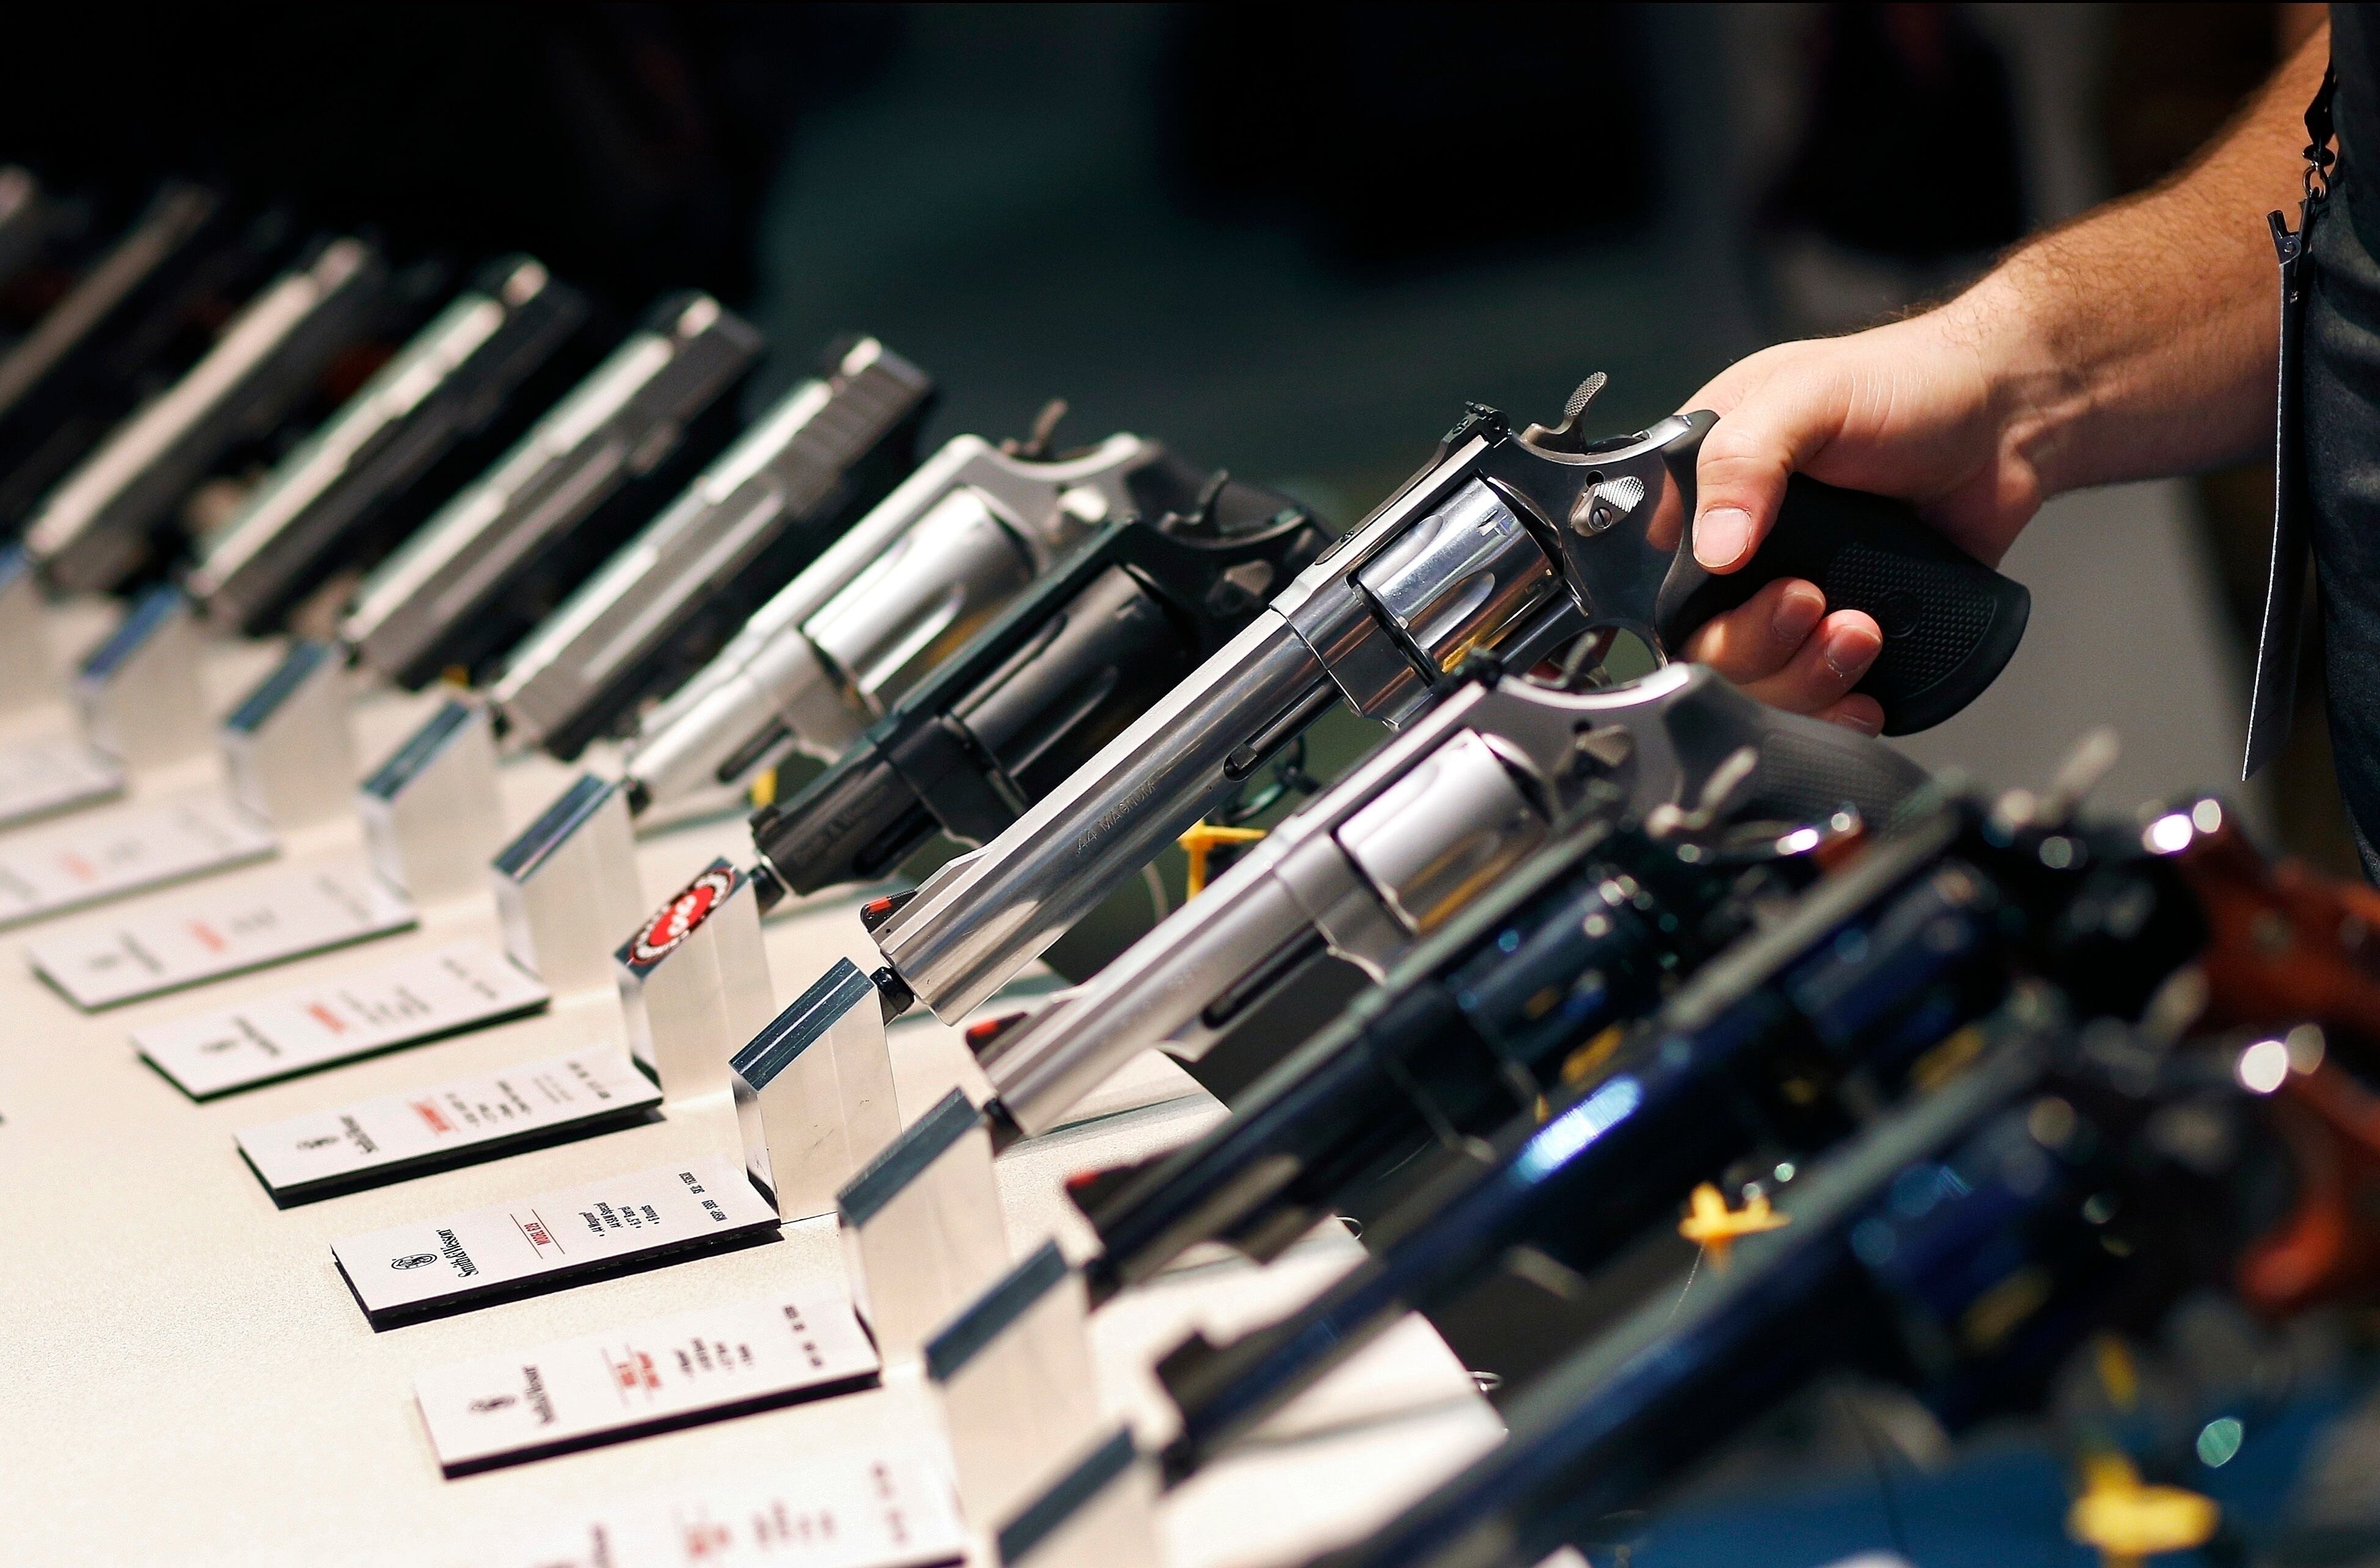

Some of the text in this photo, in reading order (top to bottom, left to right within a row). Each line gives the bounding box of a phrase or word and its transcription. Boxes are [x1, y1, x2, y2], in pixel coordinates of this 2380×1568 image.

[1098, 780, 1156, 832] MAGNUM
[617, 1206, 636, 1218] Barrel
[639, 1204, 658, 1219] Rounds
[524, 1222, 551, 1246] MODEL 629
